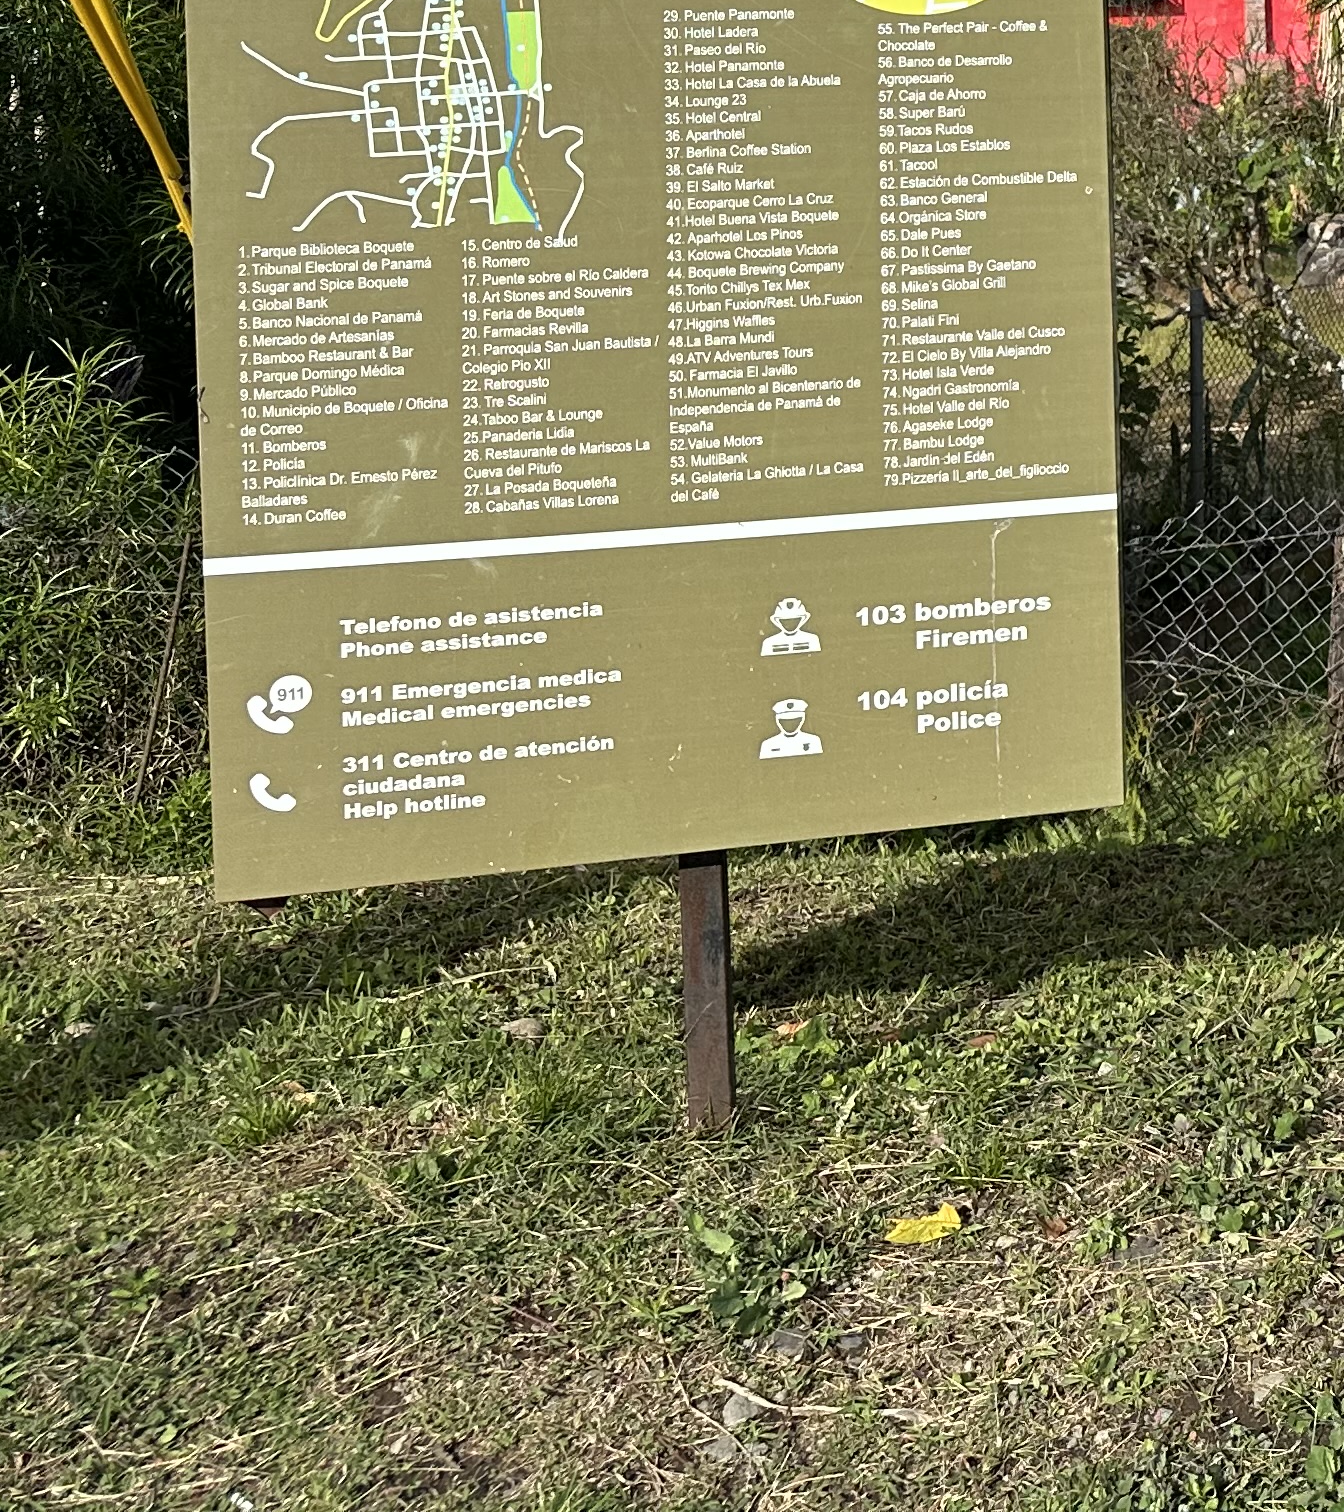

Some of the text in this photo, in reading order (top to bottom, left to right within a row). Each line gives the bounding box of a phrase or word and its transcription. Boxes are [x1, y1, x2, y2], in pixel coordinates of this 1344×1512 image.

[664, 26, 759, 40] 30. Hotel Ladera
[878, 39, 935, 52] Chocolate
[665, 110, 761, 125] 35. Hotel Central
[879, 138, 1011, 155] 60. Plaza Los Establos
[880, 191, 987, 207] 63. Banco General
[462, 256, 531, 270] 16. Romero
[462, 322, 589, 340] 20. Farmacias Revilla
[882, 416, 994, 434] 76. Agaseke Lodge
[241, 440, 327, 455] 11. Bomberos
[670, 452, 749, 469] 53. MultiBank
[464, 495, 619, 515] 28. Cabañas Villas Lorena
[242, 508, 347, 526] 14. Duran Coffee
[339, 602, 603, 635] Telefono de asistencia
[856, 595, 1051, 626] 103 bomberos
[340, 631, 547, 659] Phone assistance
[916, 626, 1027, 650] Firemen
[278, 687, 303, 701] 911
[340, 669, 621, 704] 911 Emergencia medica
[858, 680, 1009, 711] 104 policía
[342, 694, 591, 727] Medical emergencies
[918, 710, 1001, 734] Police
[342, 735, 614, 773] 311 Centro de atención
[342, 774, 465, 797] ciudadana
[344, 794, 486, 820] Help hotline
